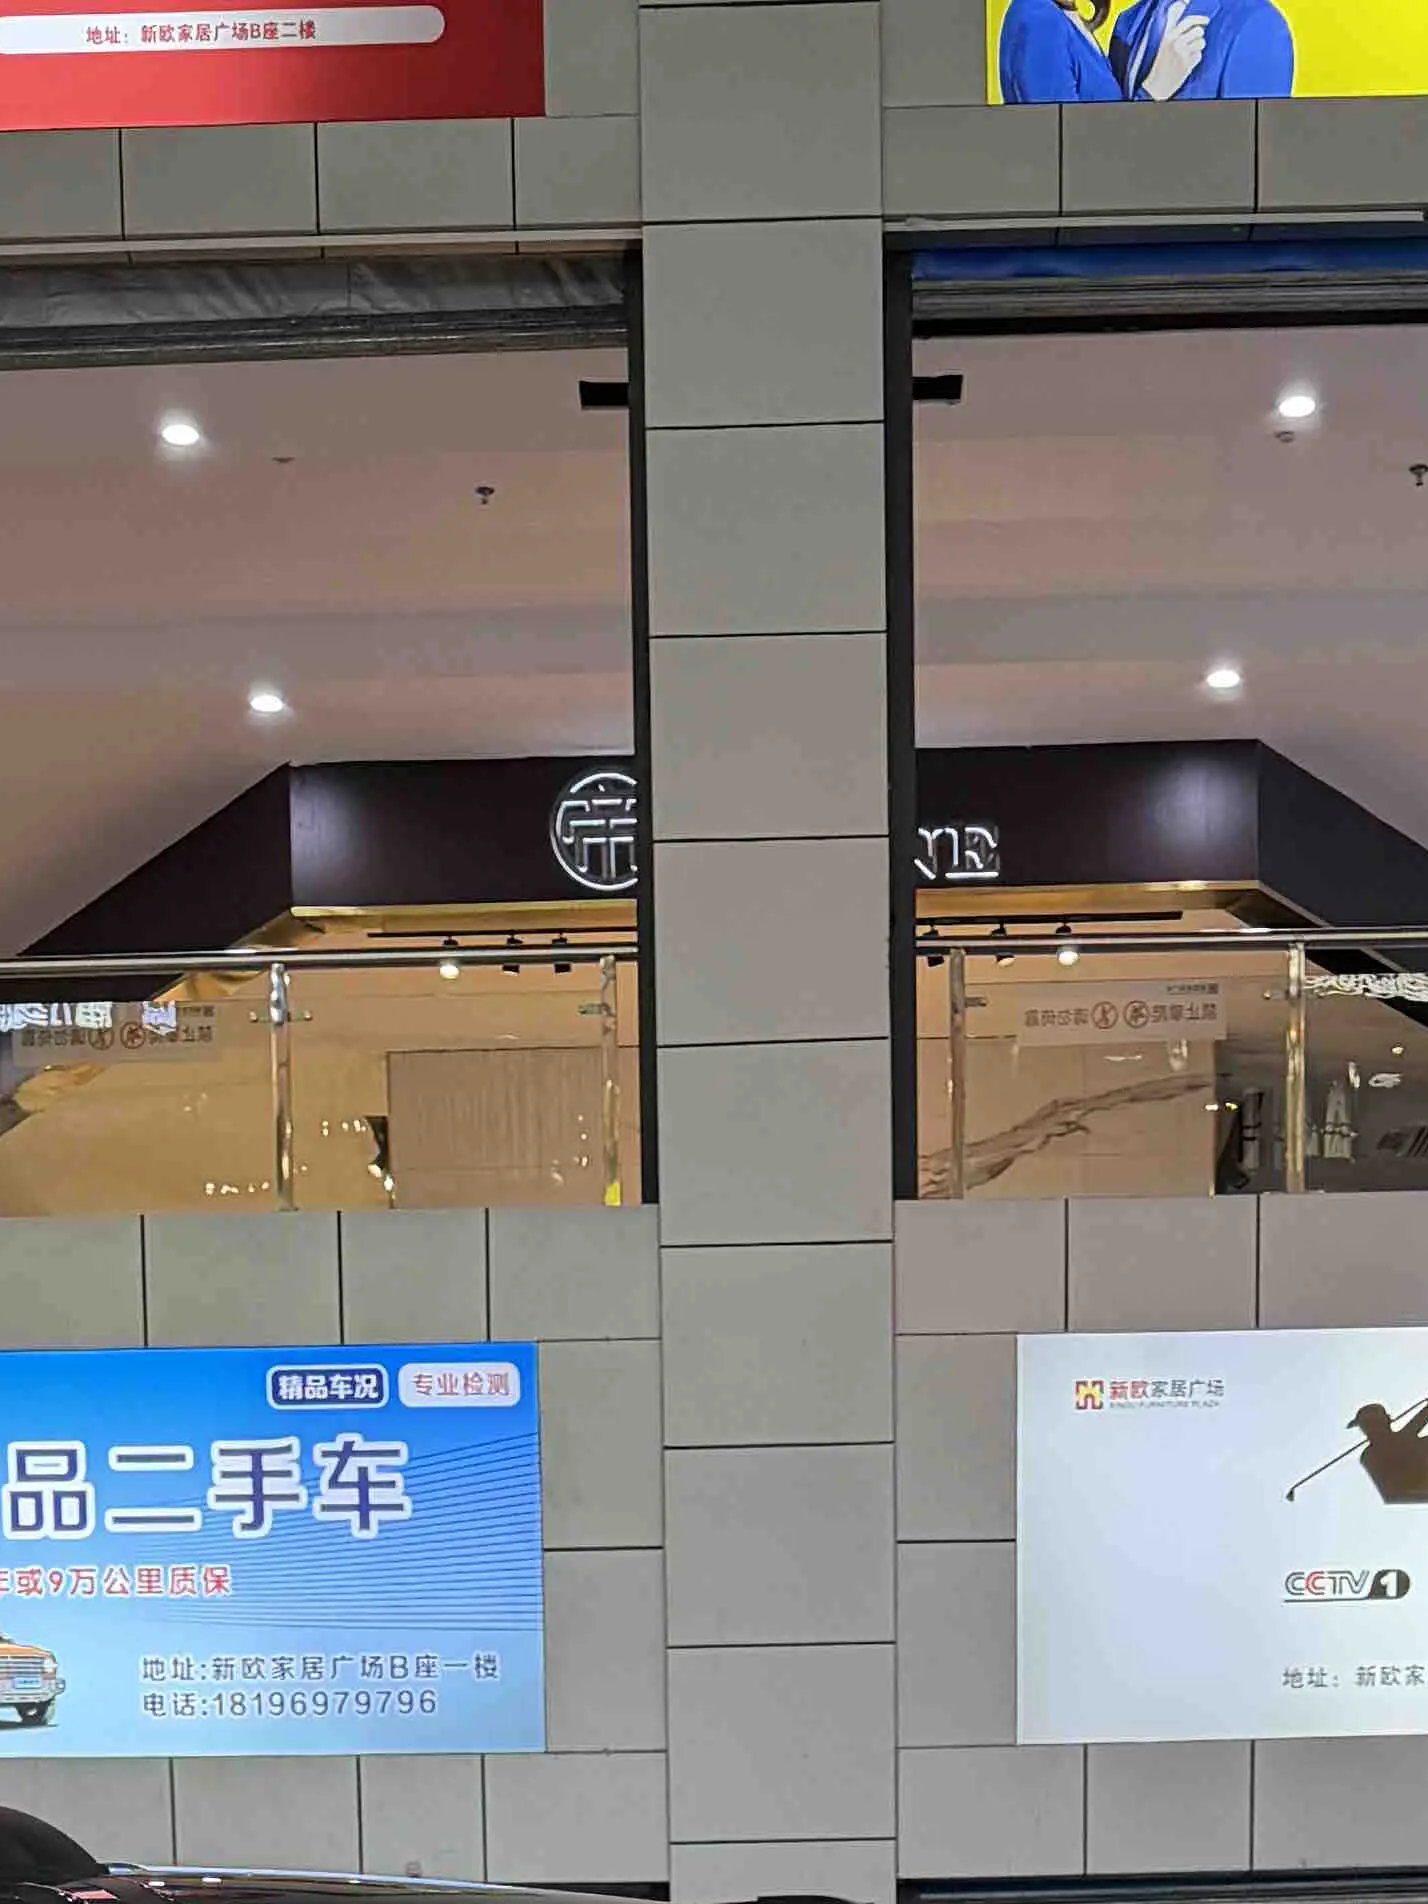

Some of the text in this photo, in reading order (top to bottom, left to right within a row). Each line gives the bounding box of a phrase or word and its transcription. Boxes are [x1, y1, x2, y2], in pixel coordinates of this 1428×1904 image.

[278, 1373, 379, 1400] 精品车况
[412, 1371, 510, 1397] 专业检测
[1109, 1379, 1225, 1400] 新欧家居广场
